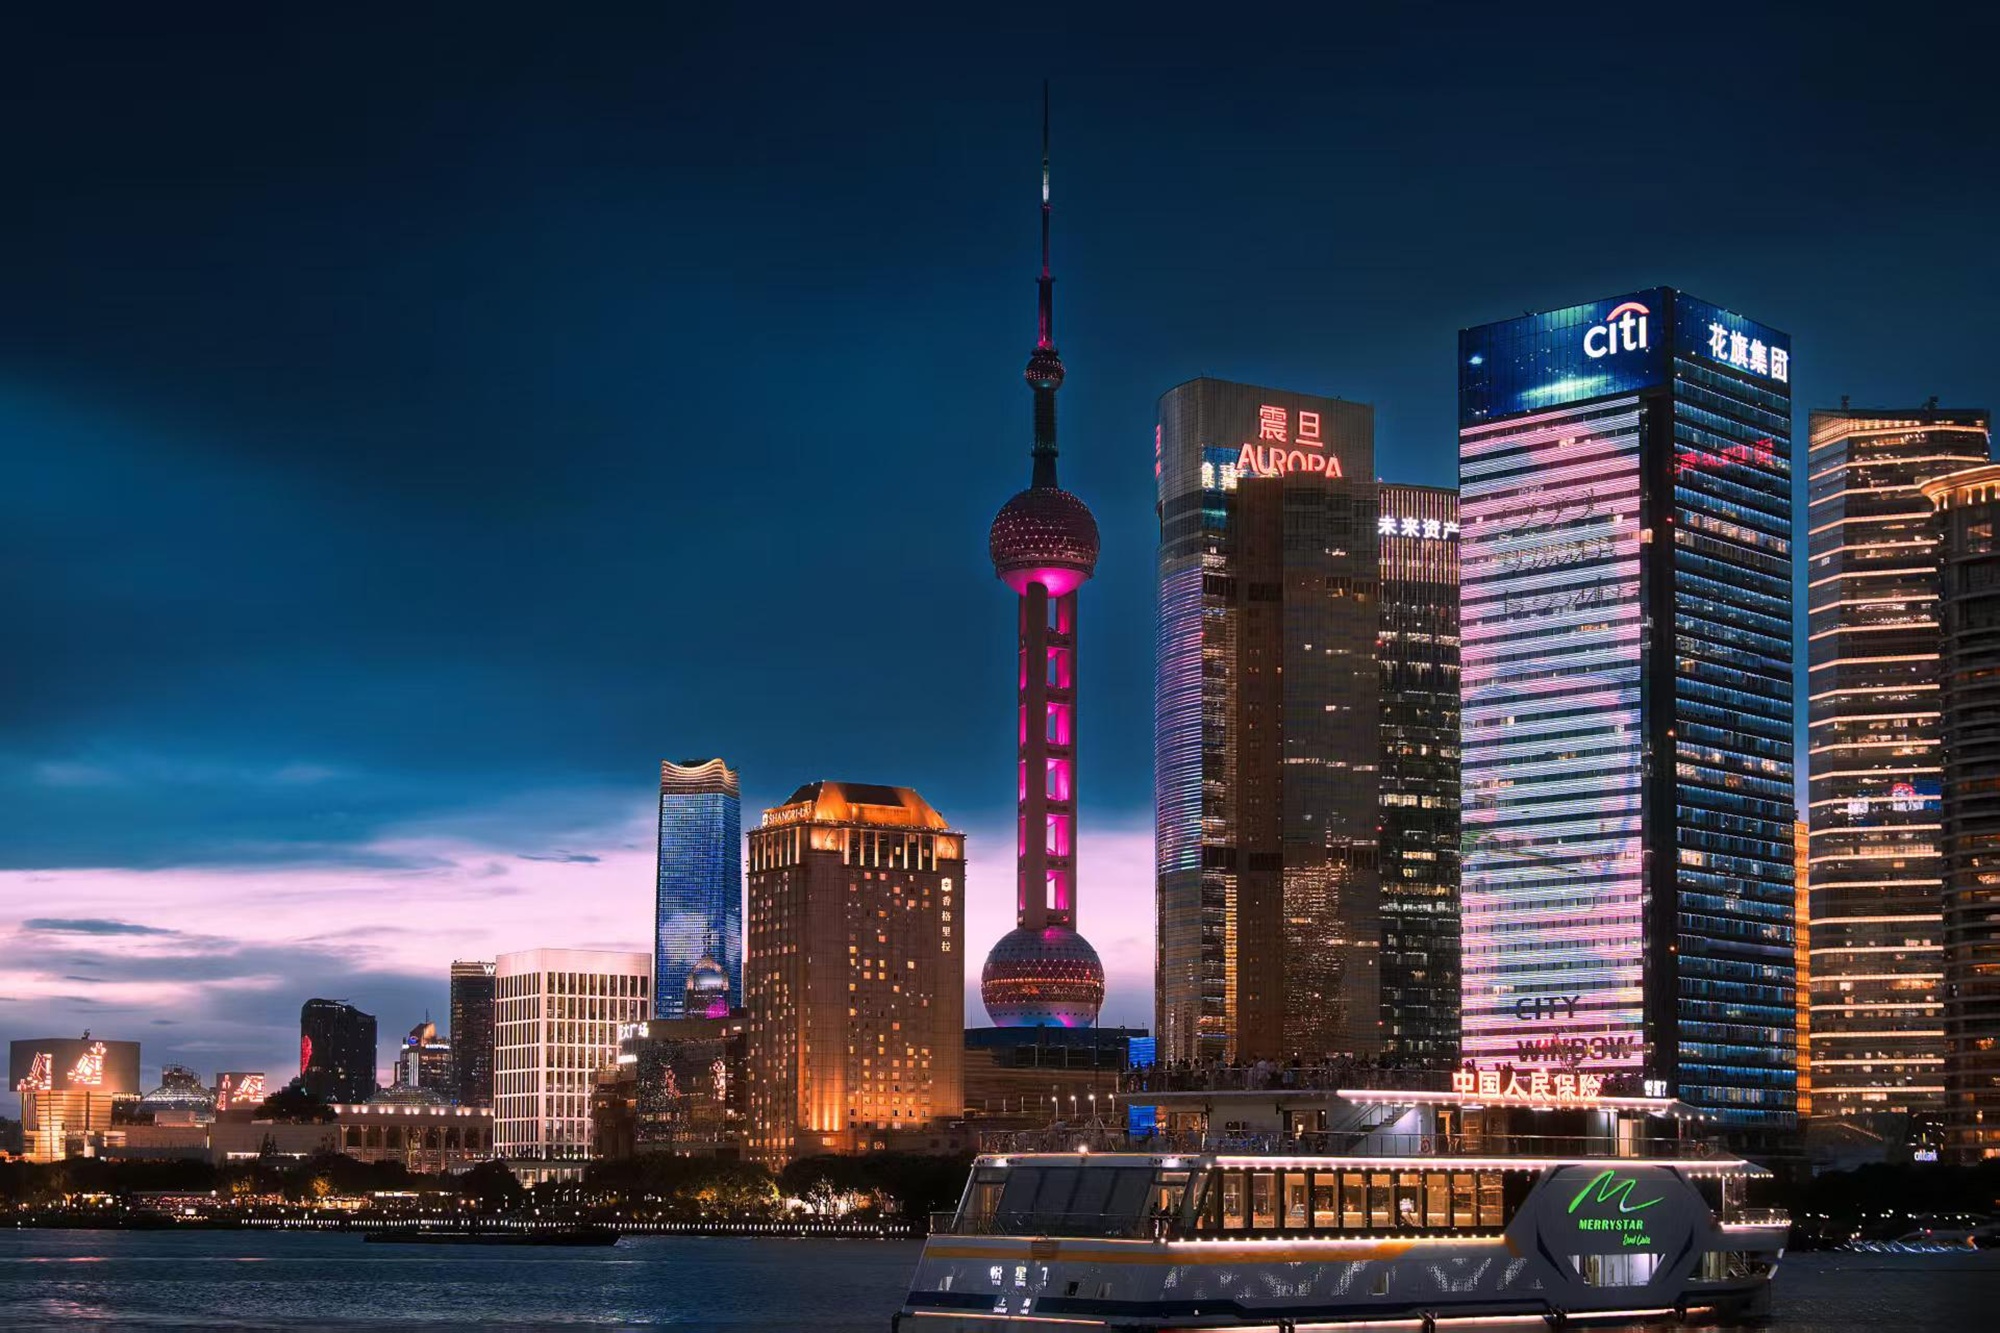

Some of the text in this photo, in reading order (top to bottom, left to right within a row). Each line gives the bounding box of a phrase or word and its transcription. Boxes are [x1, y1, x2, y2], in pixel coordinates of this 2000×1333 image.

[1583, 302, 1649, 358] citi
[1707, 322, 1789, 383] 花旗集团
[1258, 404, 1323, 448] 震旦
[1378, 515, 1459, 539] 未来资产
[941, 896, 951, 952] 香格里拉
[1516, 996, 1580, 1020] CITY
[1517, 1036, 1633, 1062] WINDOW
[1452, 1069, 1600, 1101] 中国人民保险
[1579, 1219, 1643, 1230] MERRYSTAR
